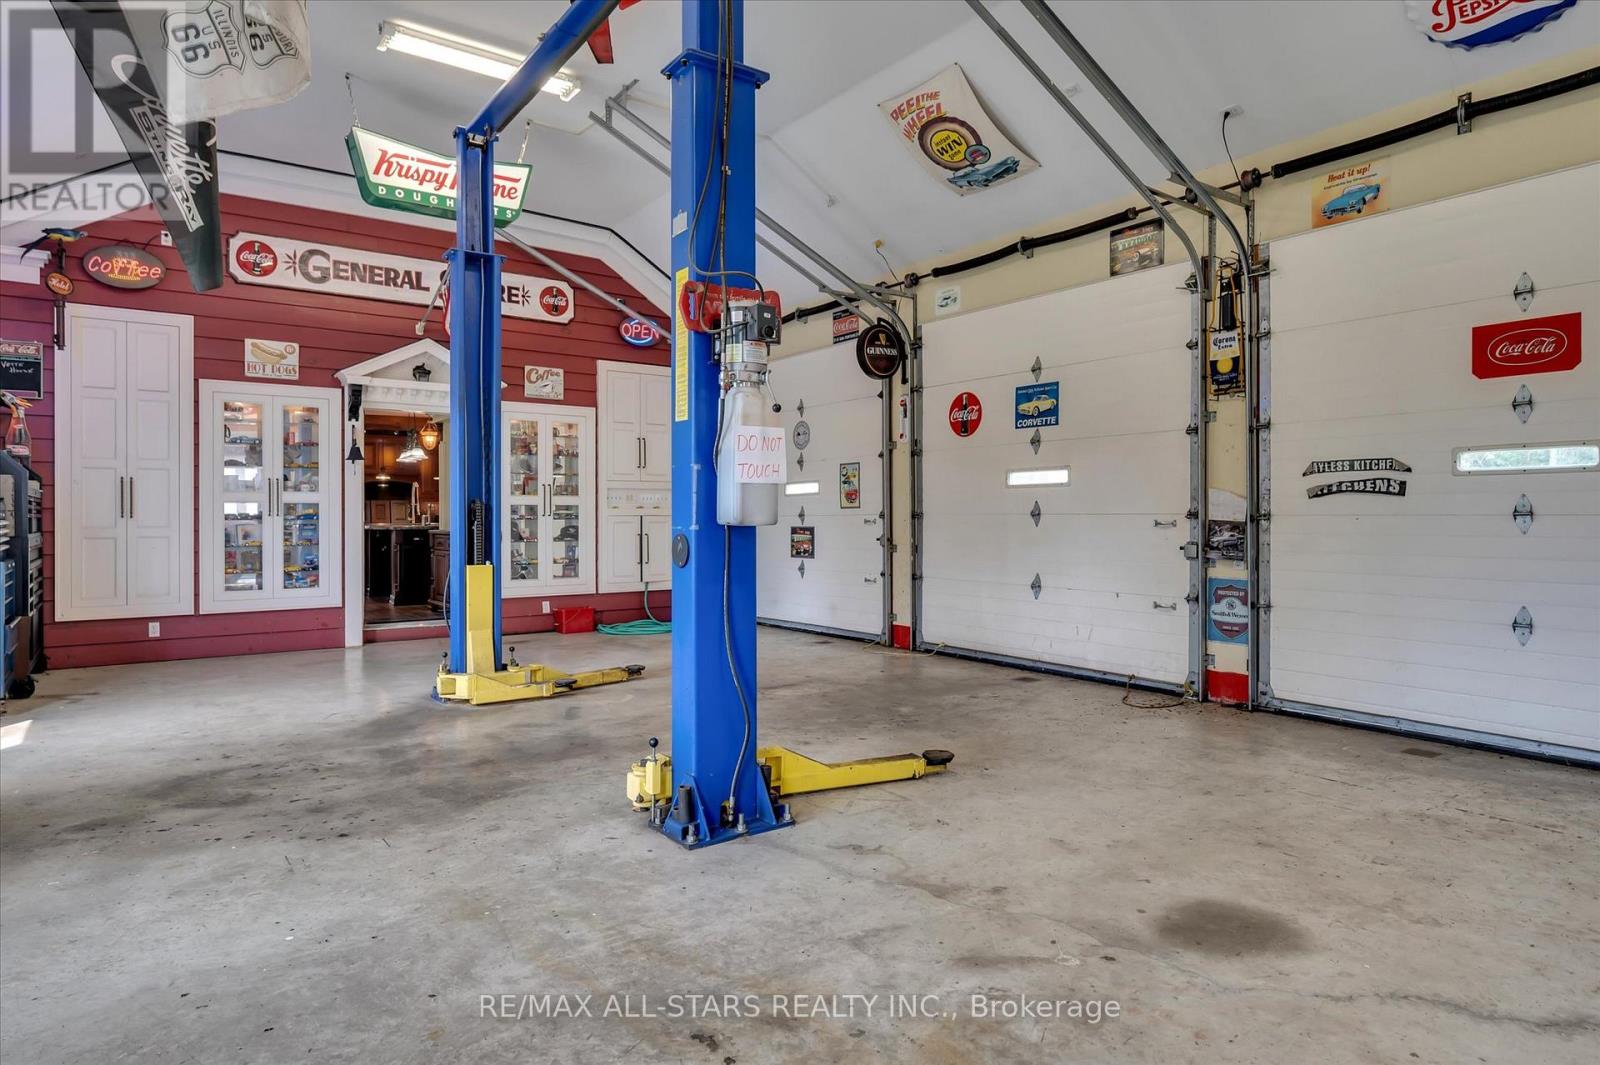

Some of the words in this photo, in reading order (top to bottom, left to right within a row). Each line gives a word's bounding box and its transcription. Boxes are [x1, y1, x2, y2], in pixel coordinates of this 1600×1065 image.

[171, 22, 210, 63] 66
[213, 9, 240, 59] ILLINOIS
[890, 95, 925, 123] PEEL
[920, 90, 941, 102] THE
[903, 103, 946, 142] WHEEL
[936, 136, 964, 157] WIN
[373, 149, 449, 191] Krispy
[1327, 171, 1346, 183] Heat
[1347, 168, 1354, 177] it
[378, 185, 513, 219] DOUGHTS
[88, 255, 162, 280] Coffee
[621, 323, 660, 339] OPEN
[866, 346, 898, 356] GUINNESS
[1212, 336, 1236, 347] Corona
[1495, 336, 1558, 358] Coca-Cola
[526, 367, 561, 385] Coffee
[950, 405, 980, 423] Coca-Cola
[1016, 416, 1057, 428] CORVETTE
[737, 434, 758, 452] DO
[761, 436, 783, 452] NOT
[737, 462, 781, 480] TOUCH
